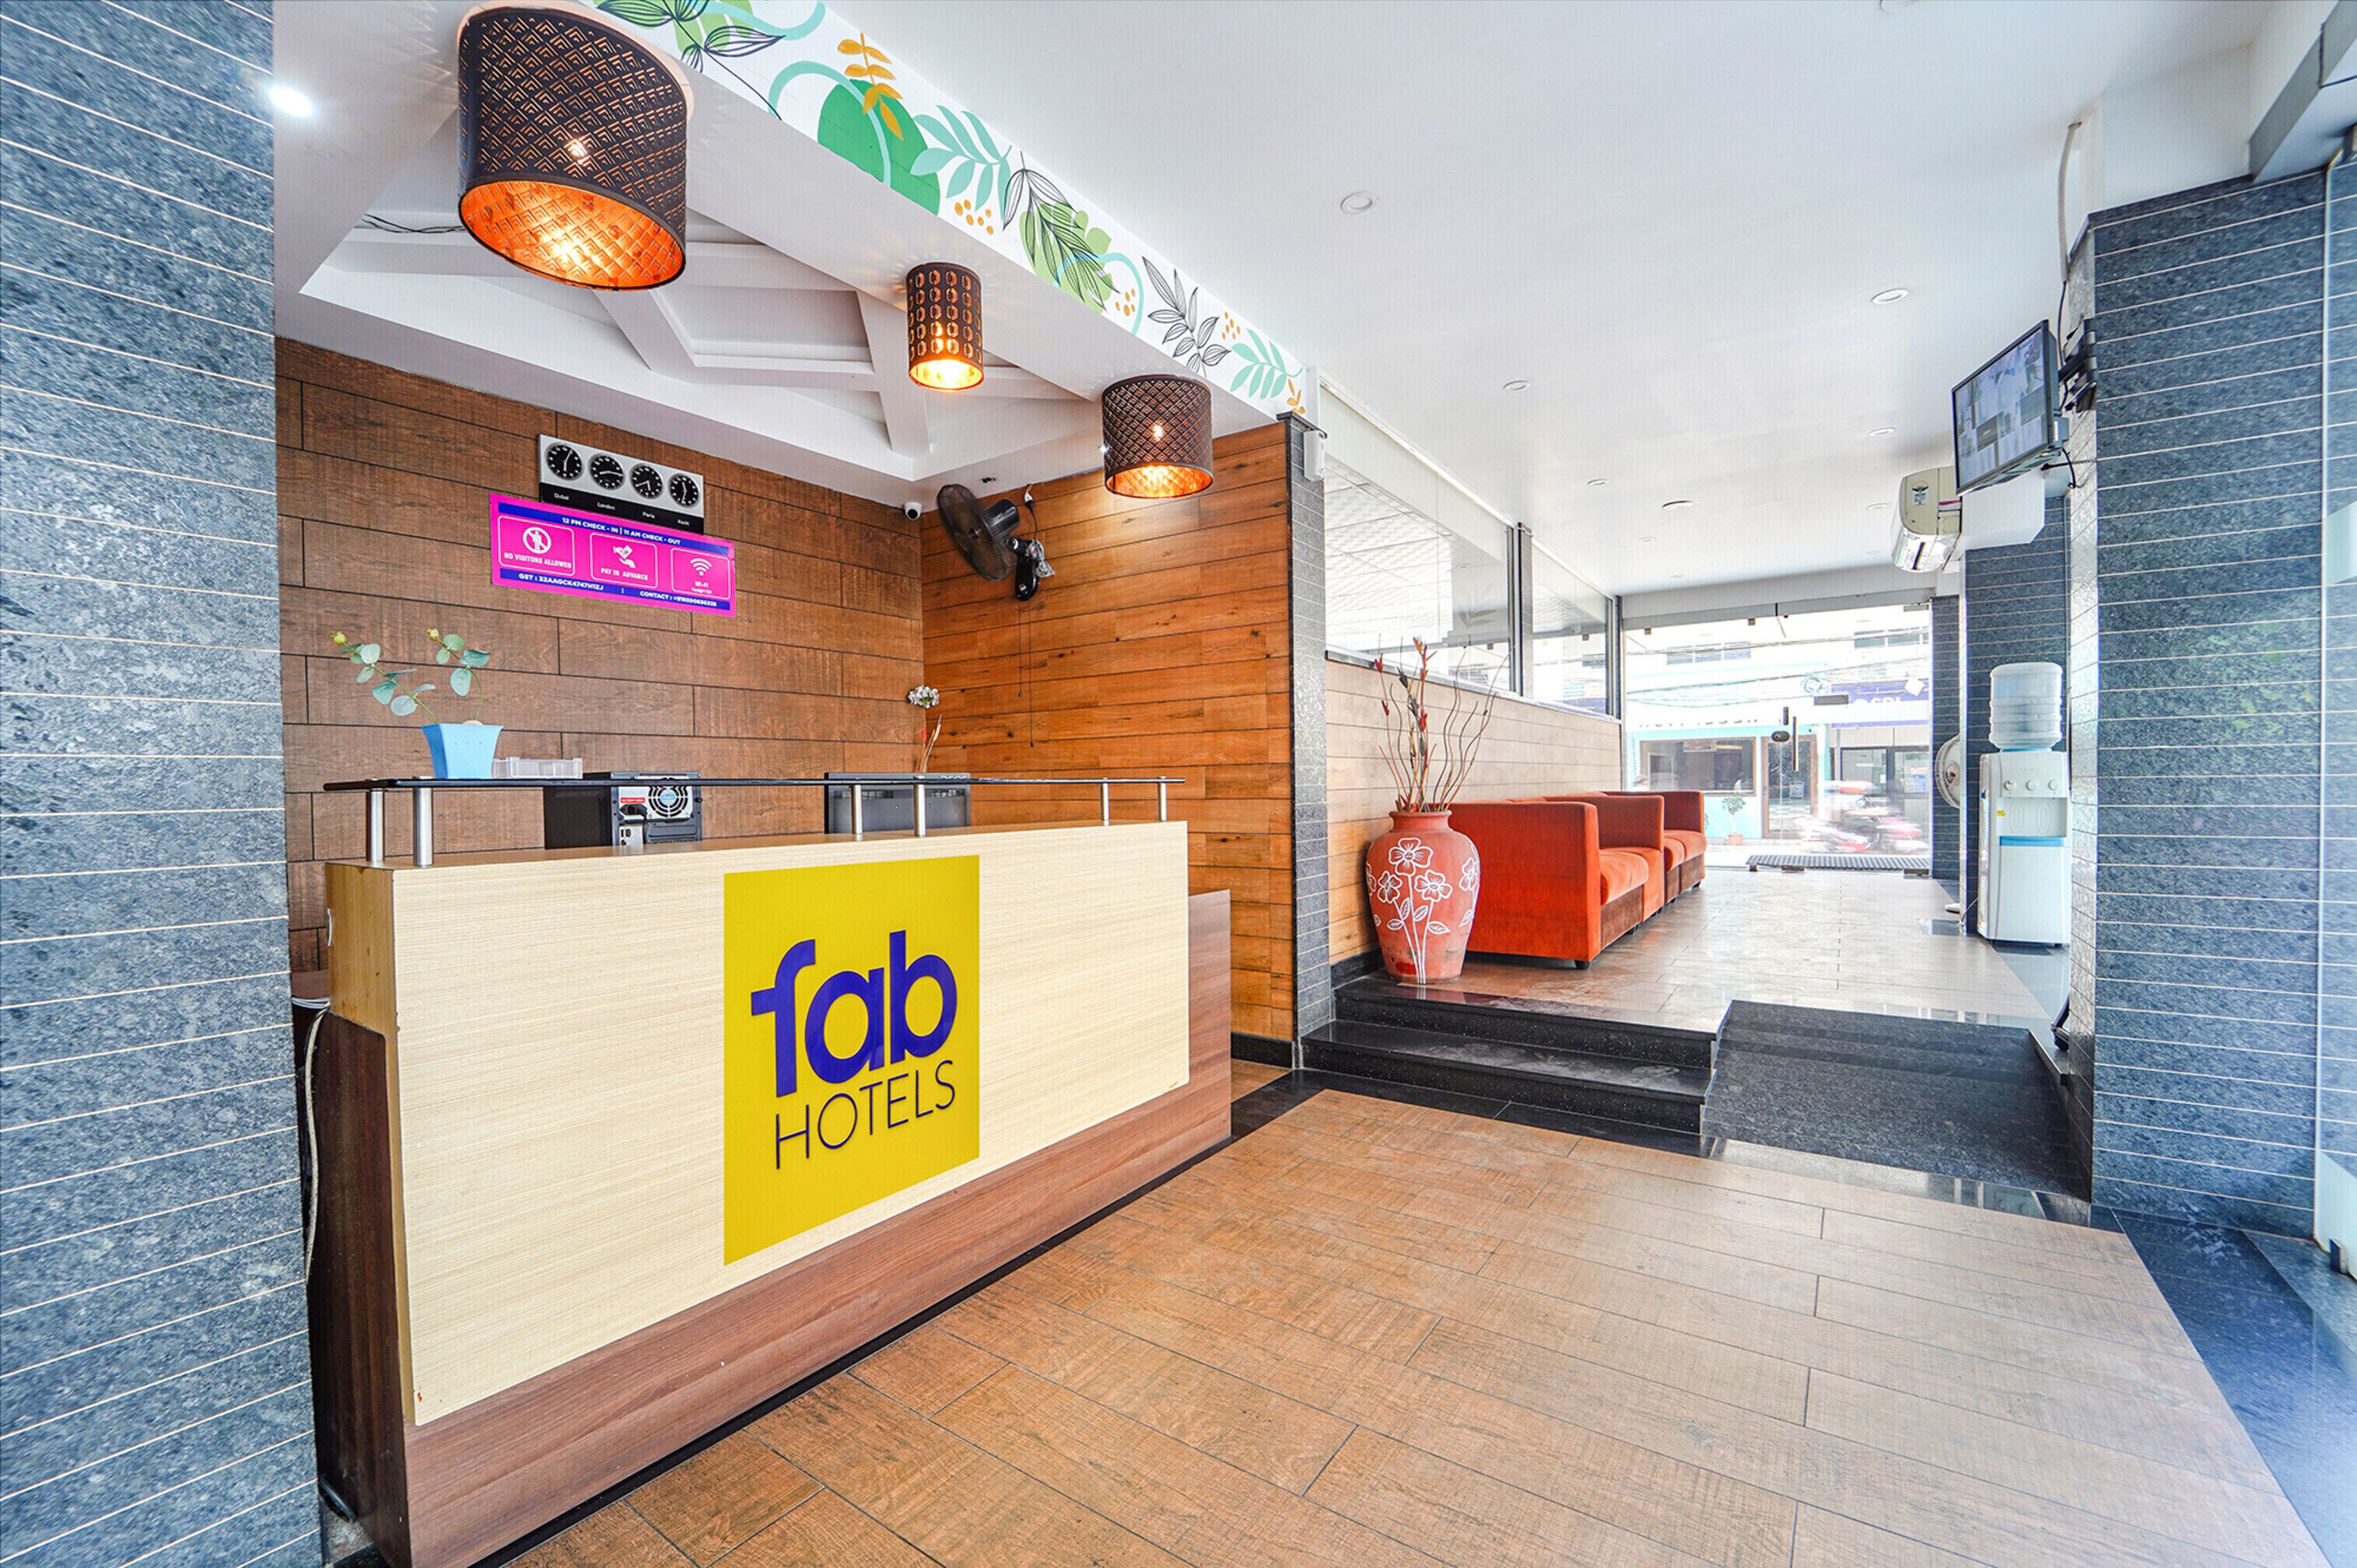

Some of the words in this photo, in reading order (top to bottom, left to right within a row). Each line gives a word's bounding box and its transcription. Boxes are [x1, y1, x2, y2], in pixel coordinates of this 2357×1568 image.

[583, 521, 605, 530] CHECK
[642, 532, 663, 542] CHECK
[515, 554, 543, 564] VISITORS
[545, 558, 572, 569] ALLOWED
[622, 571, 649, 581] ADVANCE
[639, 591, 669, 600] CONTACT
[751, 929, 958, 1098] fab
[776, 1059, 955, 1170] HOTELS
